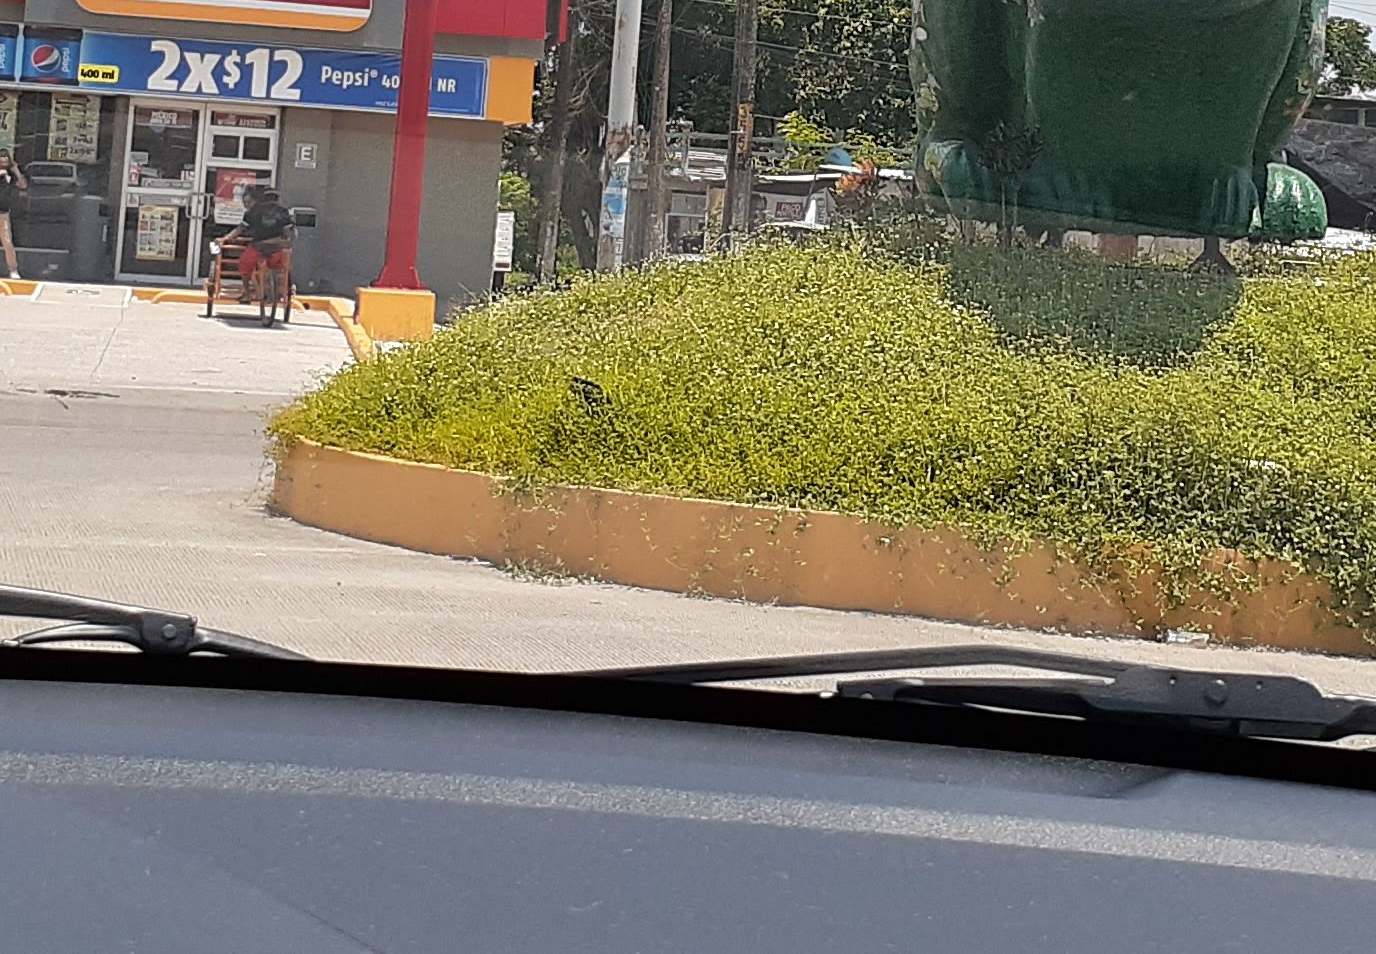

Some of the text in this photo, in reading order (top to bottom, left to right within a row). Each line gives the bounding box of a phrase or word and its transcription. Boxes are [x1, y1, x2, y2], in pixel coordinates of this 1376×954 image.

[61, 47, 70, 73] pepsi
[147, 40, 304, 100] 2x$12
[80, 68, 115, 80] 400 ml
[437, 78, 457, 93] NR
